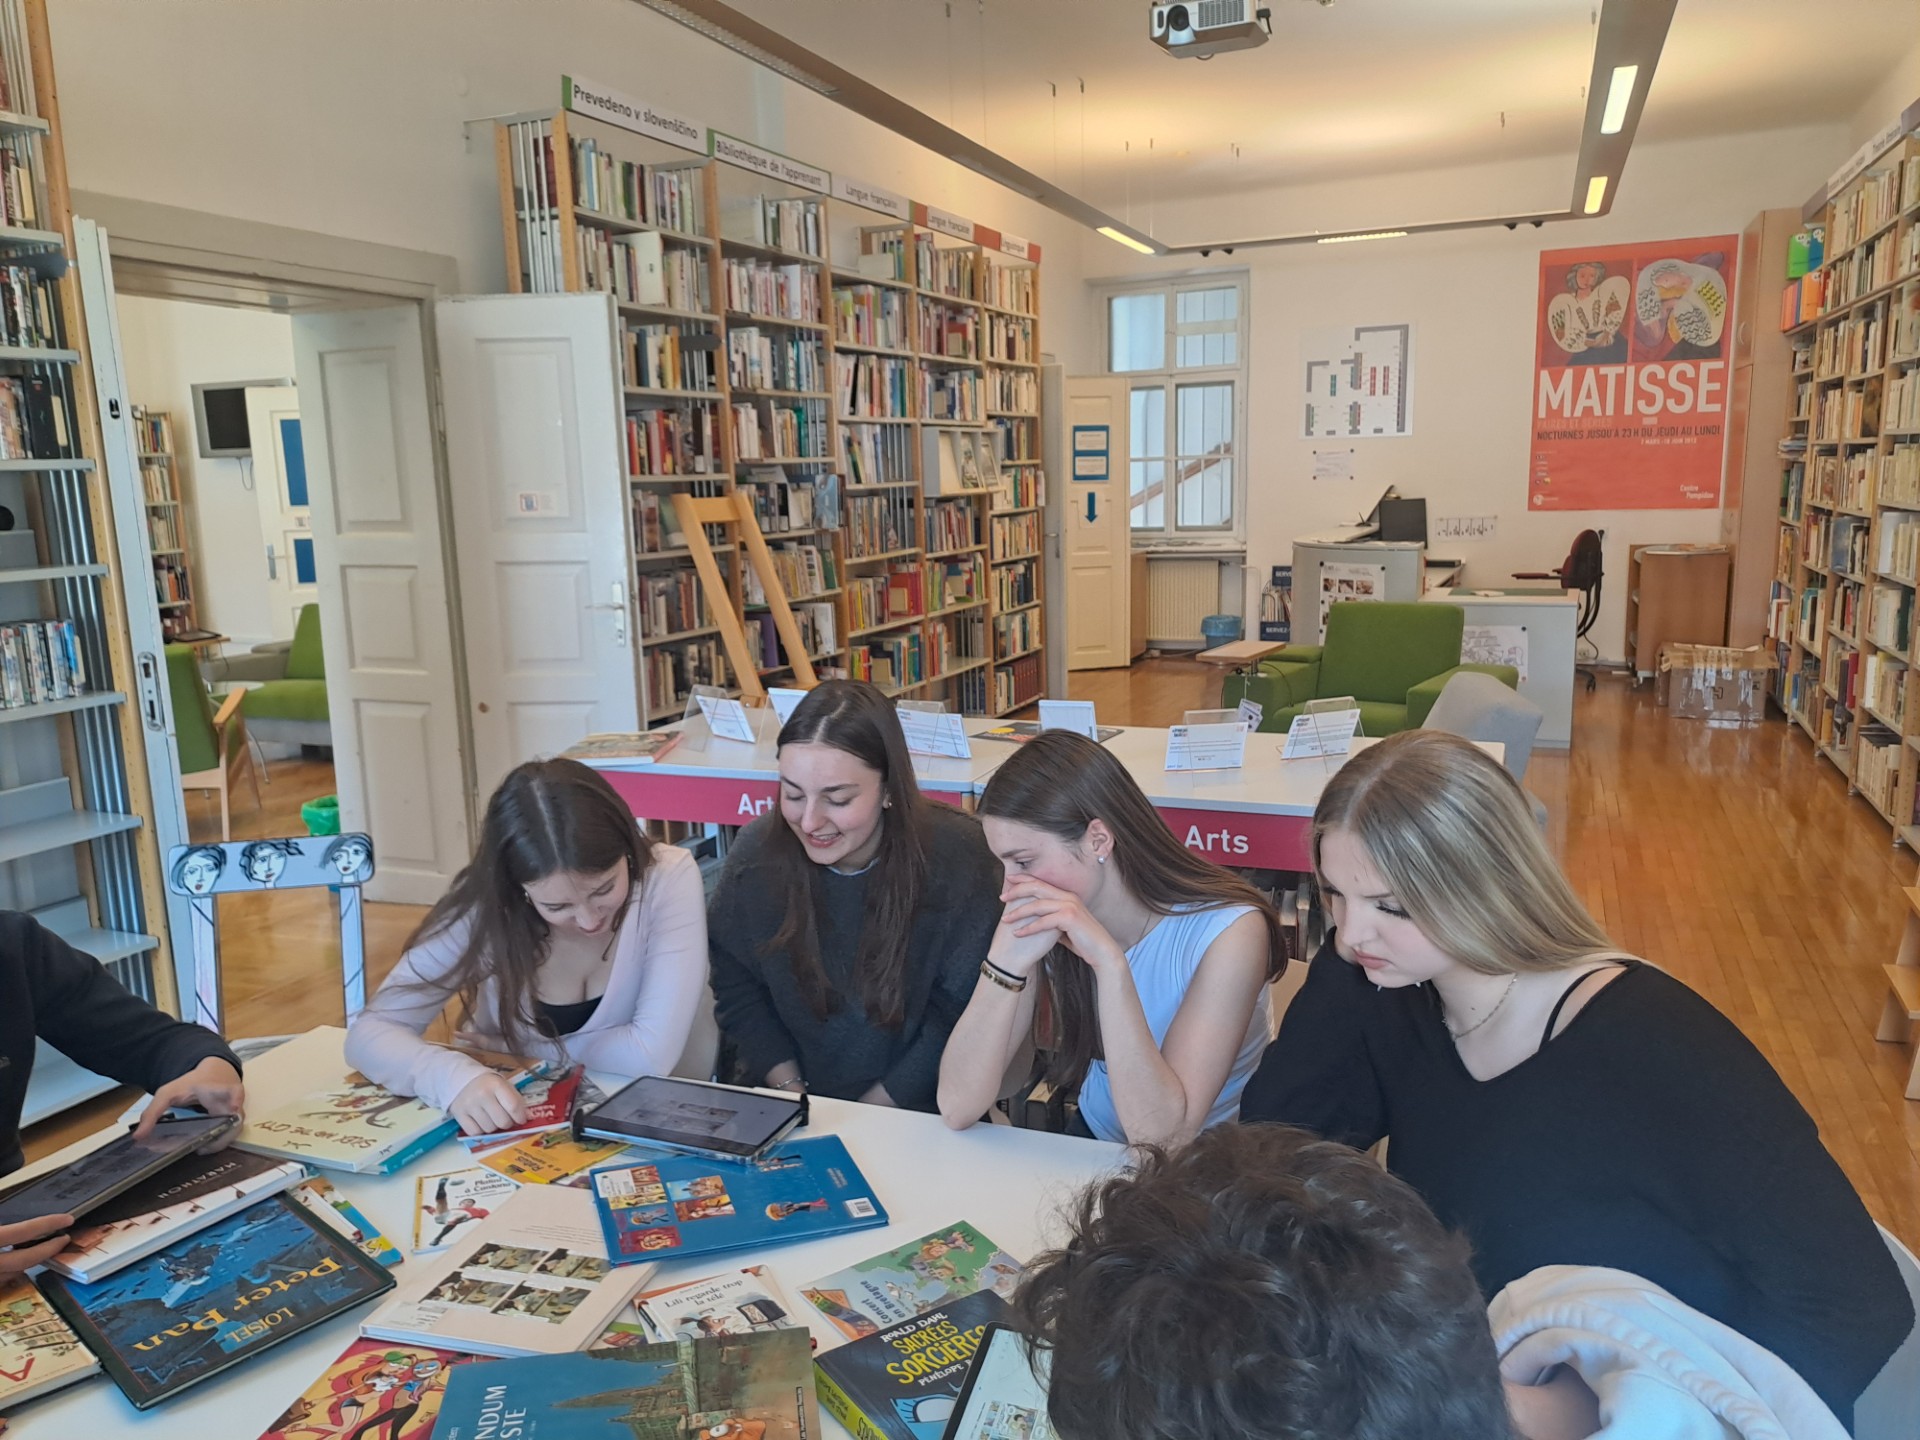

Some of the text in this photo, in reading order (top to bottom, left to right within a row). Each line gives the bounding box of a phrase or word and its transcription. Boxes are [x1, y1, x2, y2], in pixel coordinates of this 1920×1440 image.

[573, 84, 698, 140] Prevedeno v slovenščino
[716, 140, 822, 188] Bibliothèque de l'apprenant
[845, 182, 869, 202] Langue
[1537, 360, 1725, 419] MATISSE
[1537, 430, 1584, 441] NOCTURNES
[1622, 427, 1632, 438] 23
[1633, 427, 1640, 438] H
[1641, 426, 1653, 438] DU
[1655, 425, 1679, 437] JEUDI
[1681, 425, 1693, 436] AU
[1694, 424, 1721, 436] LUNDI
[737, 793, 775, 816] Art
[1184, 824, 1250, 855] Arts
[157, 1162, 237, 1199] MARATHON
[474, 1182, 511, 1192] Cantona
[233, 1256, 343, 1312] Peter
[664, 1297, 684, 1308] Lili
[685, 1286, 721, 1302] regarde
[722, 1279, 744, 1290] trop
[695, 1292, 725, 1306] la télé
[860, 1280, 895, 1311] Bretagne
[225, 1306, 296, 1343] LOISEL
[861, 1298, 893, 1324] Concert
[894, 1309, 906, 1319] en
[131, 1307, 229, 1351] Pan
[880, 1312, 949, 1343] ROALD DAHL
[892, 1320, 959, 1355] SACRÉES
[500, 1407, 527, 1440] STE
